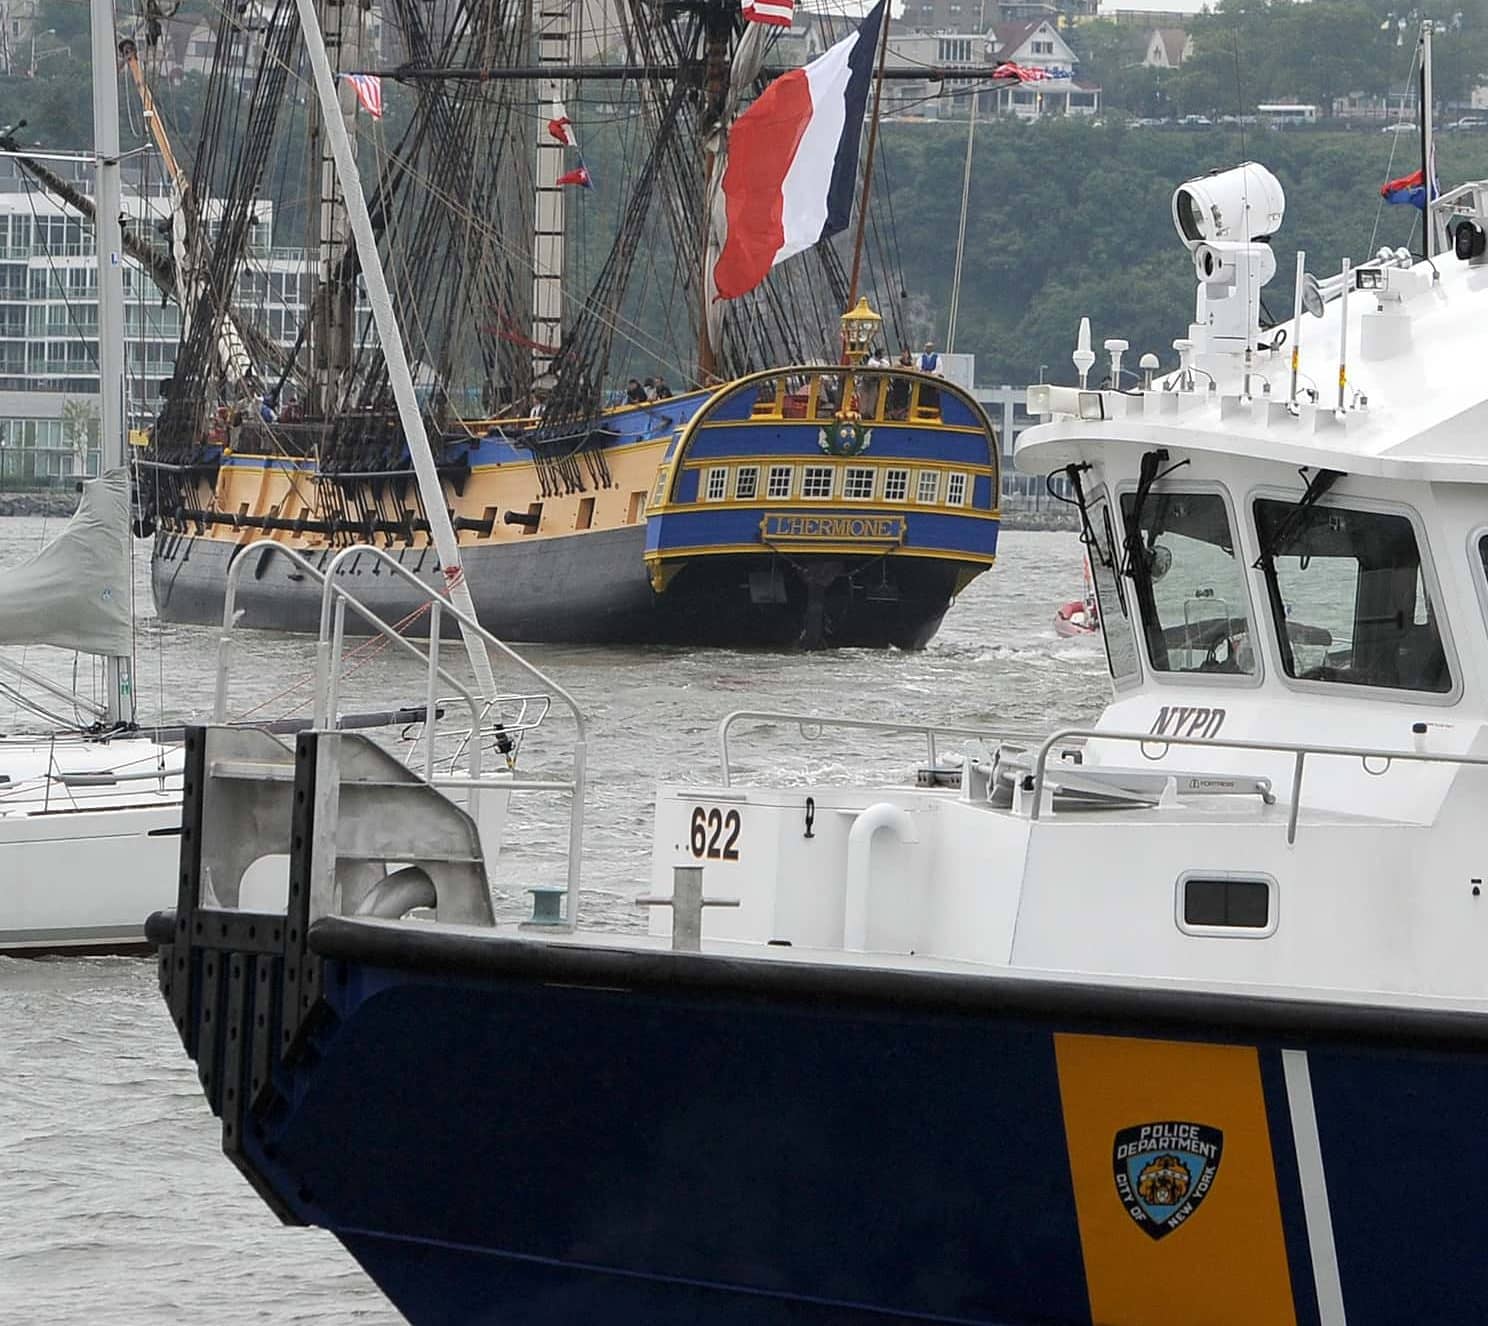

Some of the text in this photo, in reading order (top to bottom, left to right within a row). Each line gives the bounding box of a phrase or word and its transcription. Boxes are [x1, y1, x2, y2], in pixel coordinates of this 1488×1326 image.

[776, 517, 892, 536] L'HERMIONE
[1150, 706, 1226, 738] NYPD
[690, 806, 741, 861] 622
[1140, 1123, 1200, 1140] POLICE
[1117, 1137, 1217, 1159] DEPARTMENT
[1116, 1166, 1216, 1228] CITY OF NEW YORK
